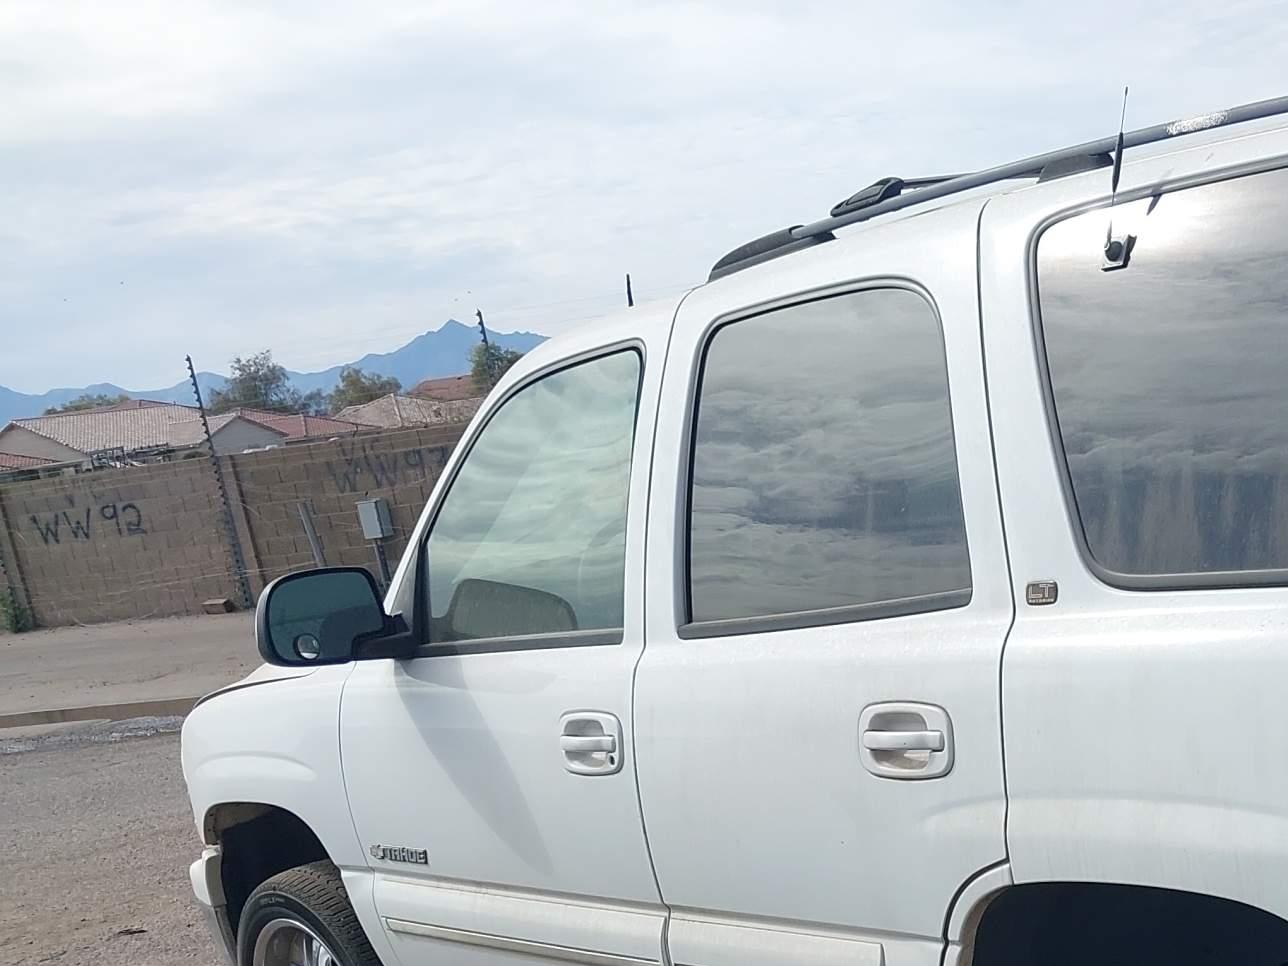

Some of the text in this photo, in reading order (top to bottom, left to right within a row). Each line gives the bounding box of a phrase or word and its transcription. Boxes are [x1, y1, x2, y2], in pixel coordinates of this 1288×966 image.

[29, 502, 148, 546] WW 92
[1028, 583, 1055, 599] LT
